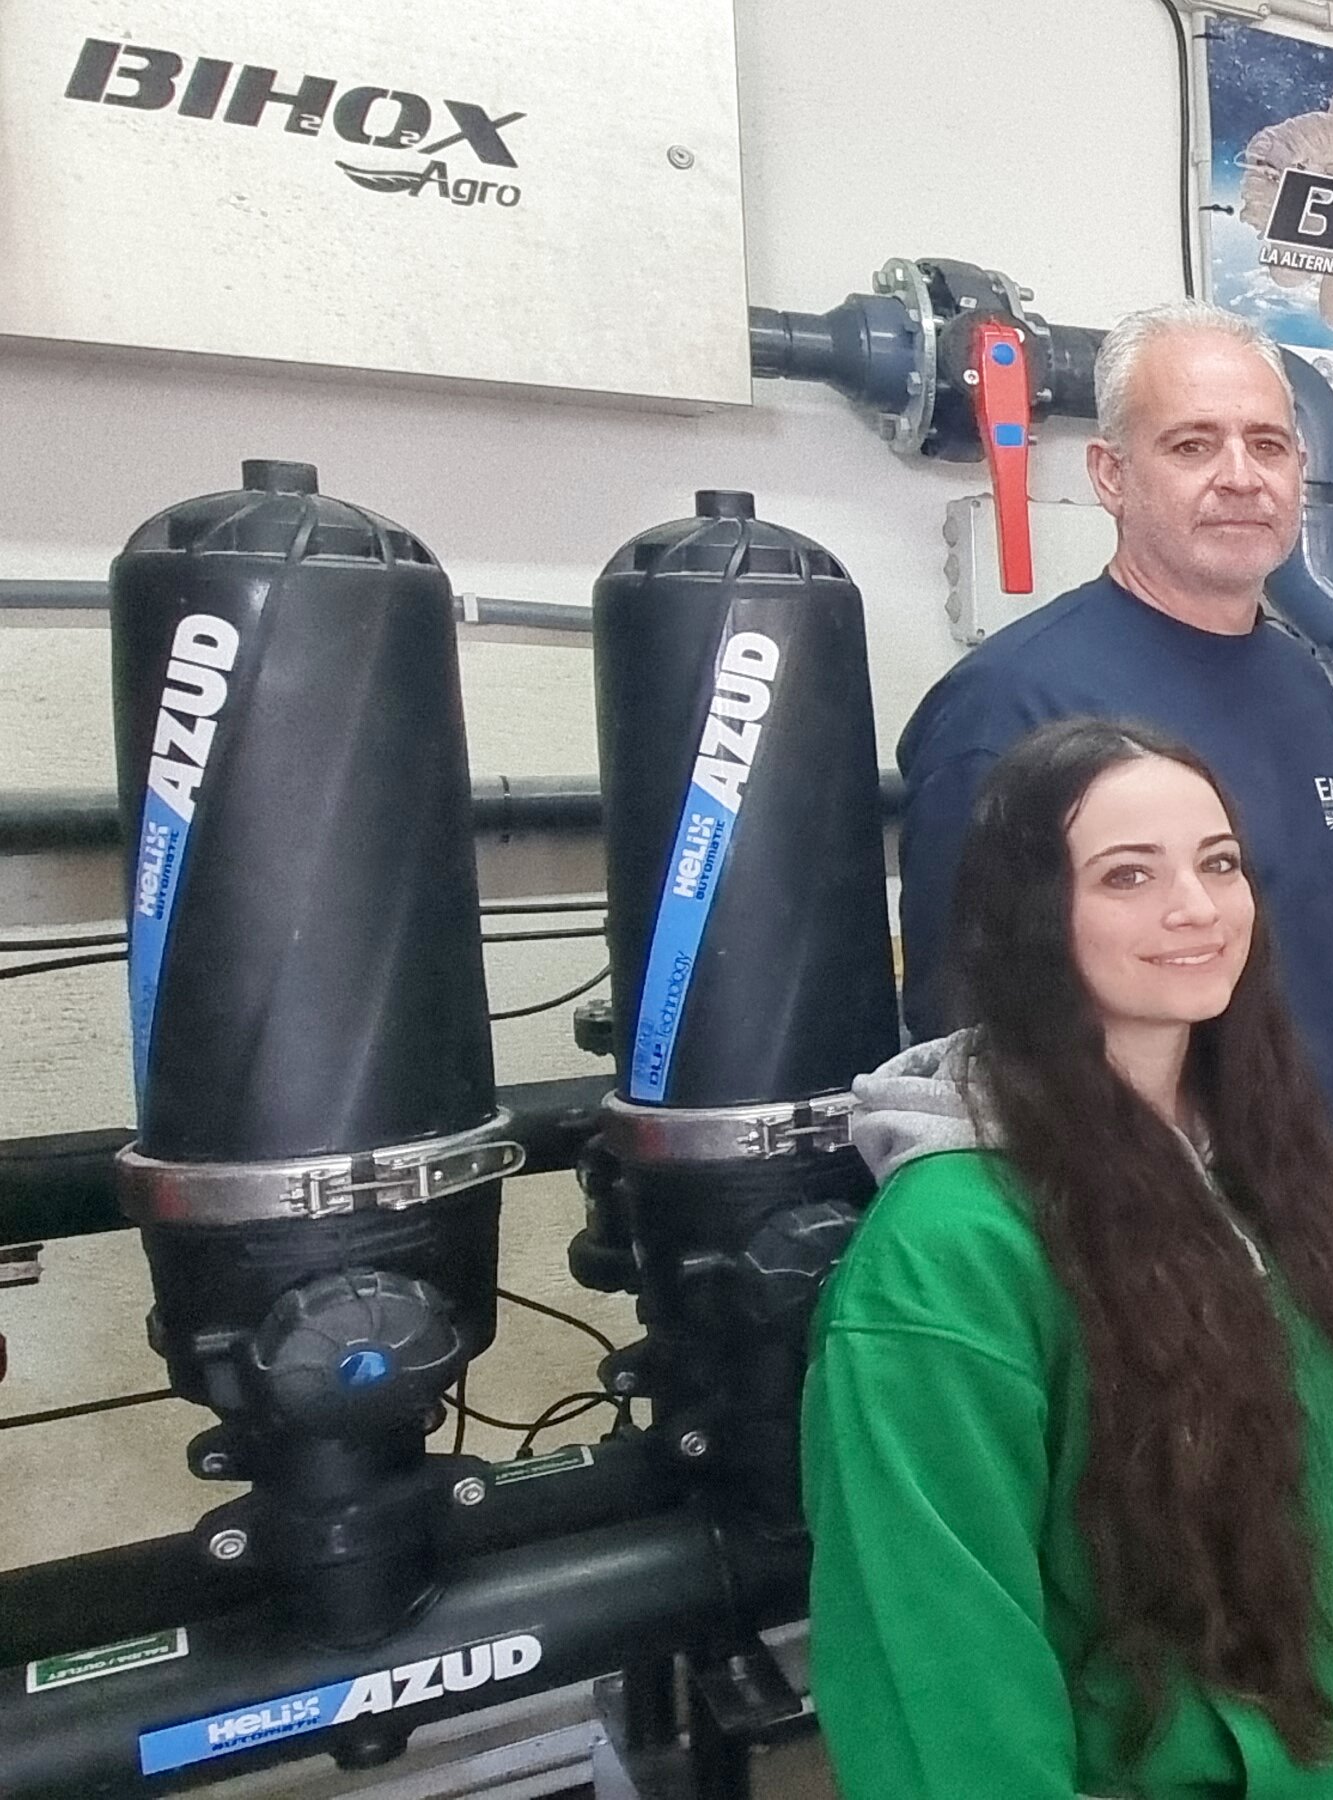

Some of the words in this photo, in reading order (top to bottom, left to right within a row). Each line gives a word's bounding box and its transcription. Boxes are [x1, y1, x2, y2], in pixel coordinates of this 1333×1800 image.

[409, 159, 521, 207] Agro
[1260, 248, 1279, 264] LA
[148, 614, 240, 823] AZUD
[692, 632, 780, 813] AZUD
[332, 1634, 541, 1724] AZUD
